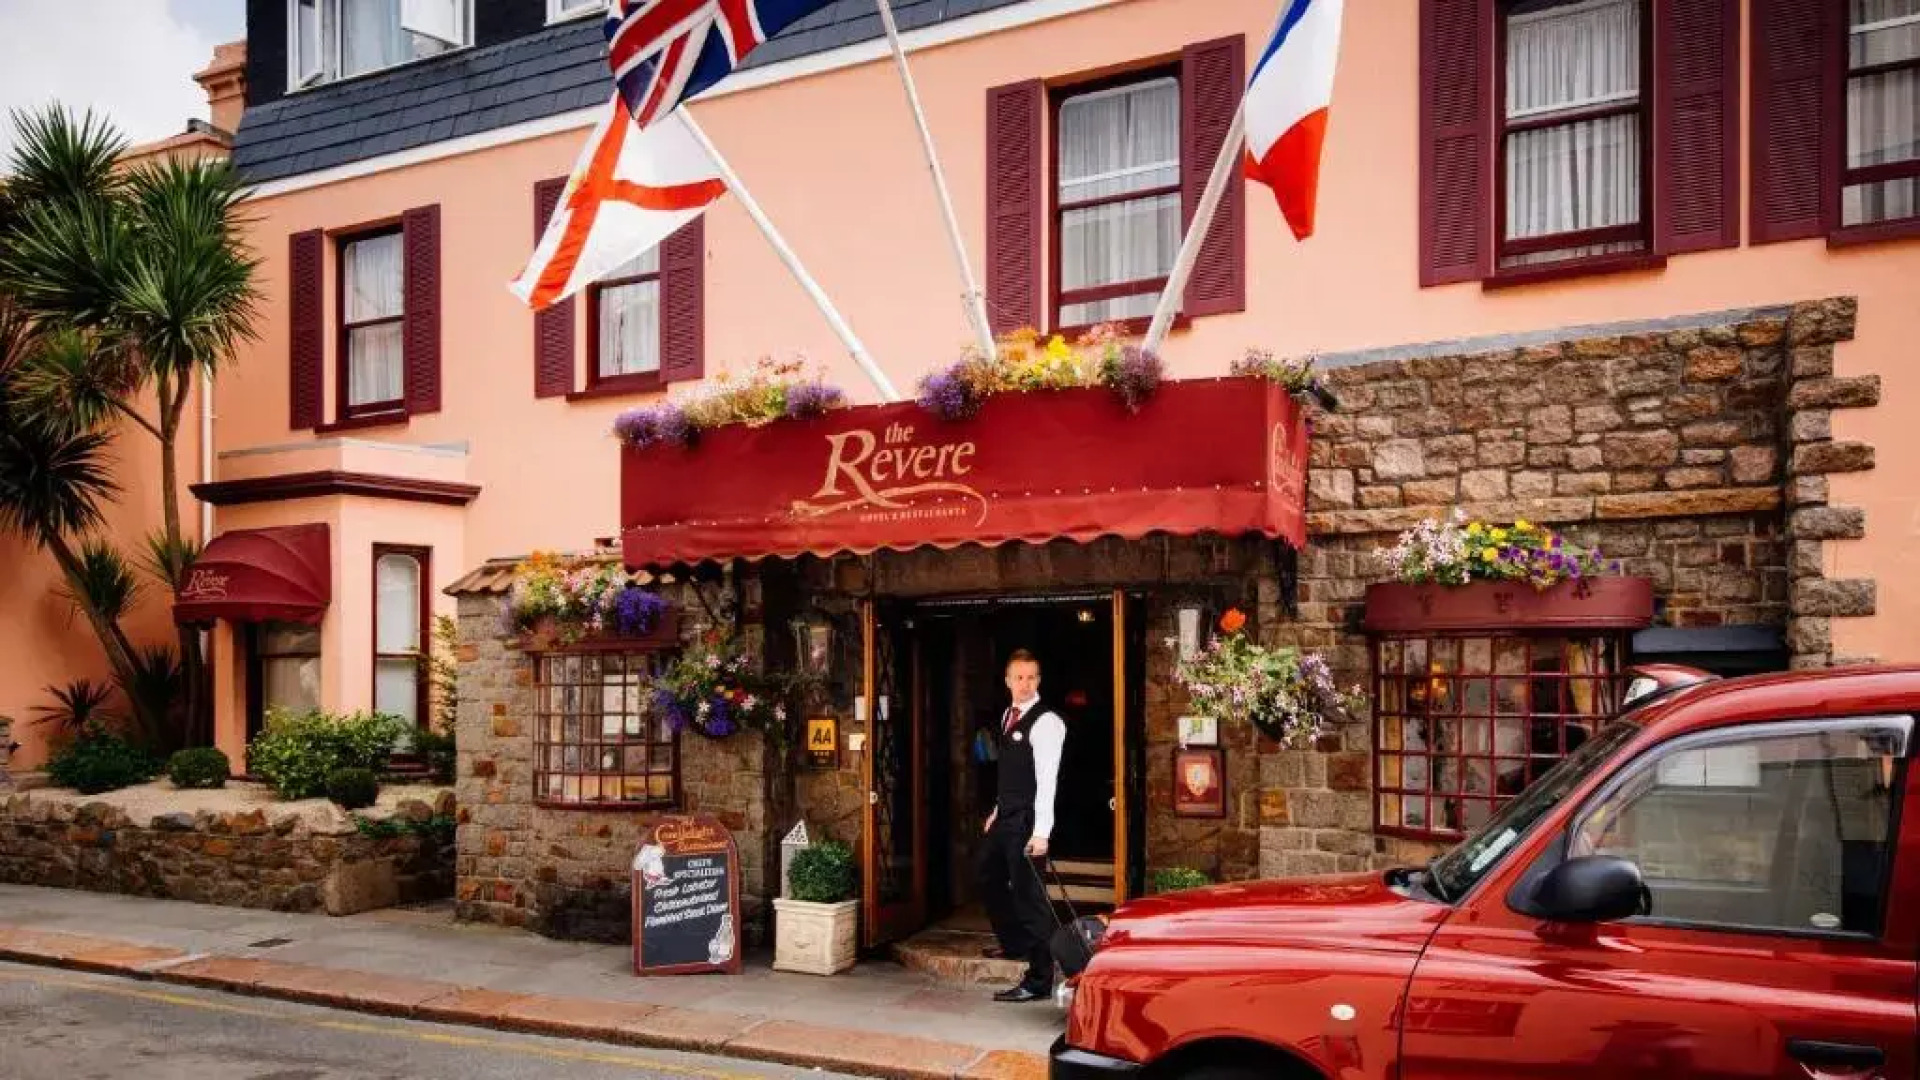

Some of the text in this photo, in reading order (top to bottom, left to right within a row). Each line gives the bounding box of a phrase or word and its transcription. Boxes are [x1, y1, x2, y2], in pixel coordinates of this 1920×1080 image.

[886, 422, 914, 443] the
[812, 429, 976, 509] Revere
[811, 727, 832, 744] AA
[654, 886, 680, 899] Fresh
[682, 879, 718, 894] Lobster
